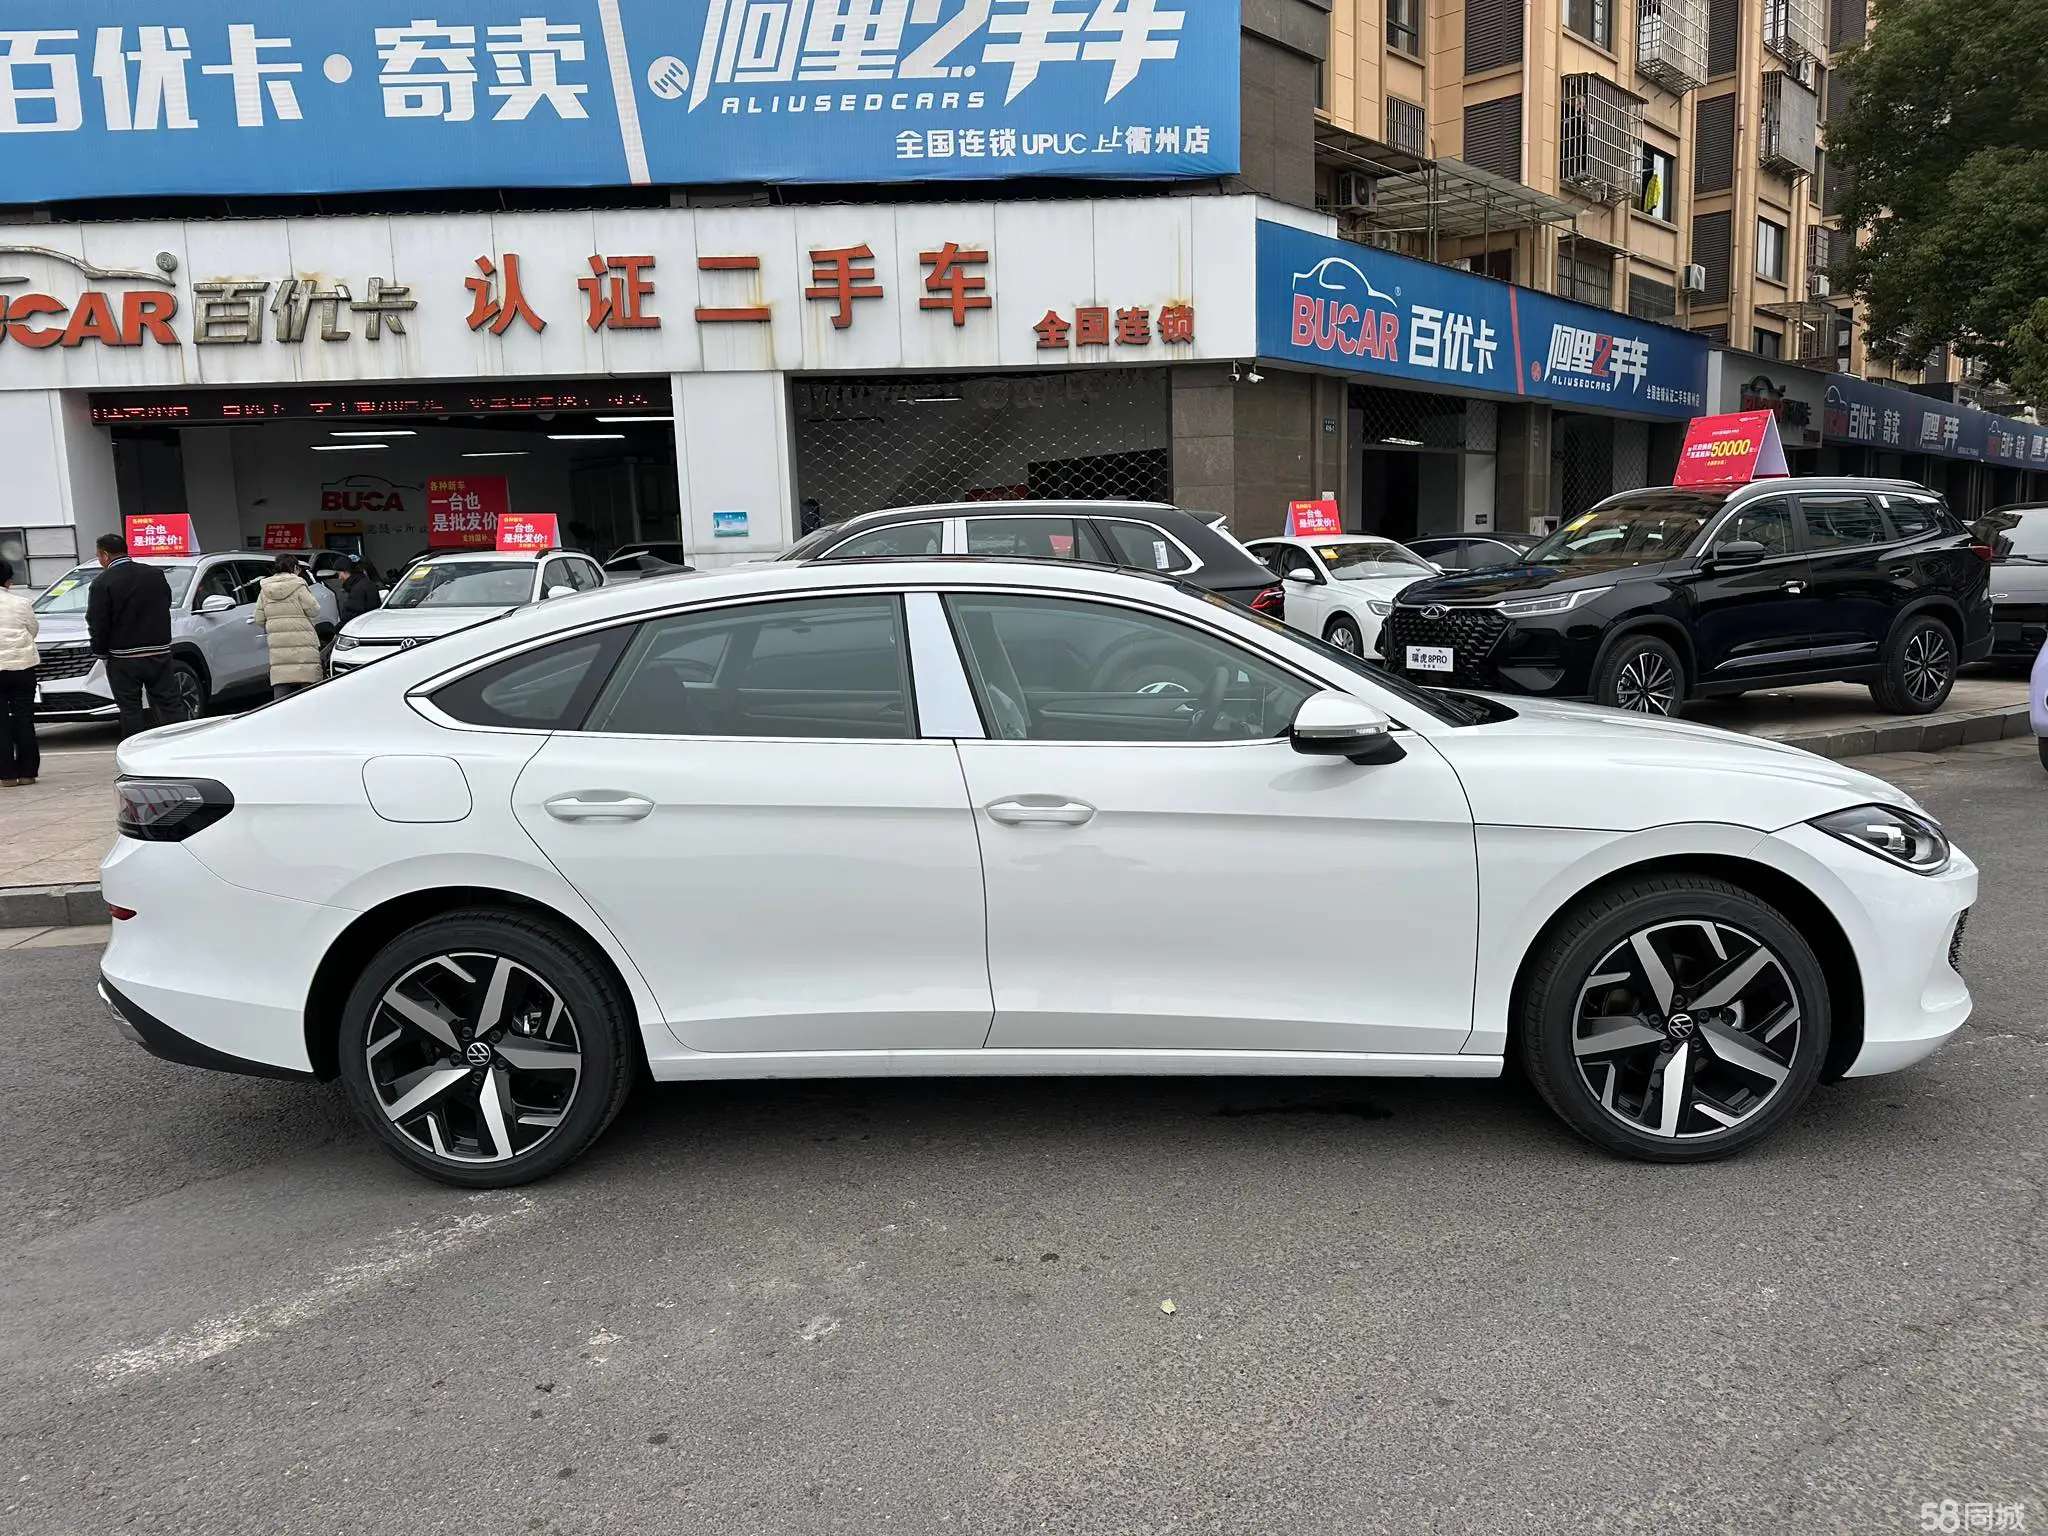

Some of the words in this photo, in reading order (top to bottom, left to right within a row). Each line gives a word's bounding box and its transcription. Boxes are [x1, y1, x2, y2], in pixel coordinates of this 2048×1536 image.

[721, 91, 985, 114] ALIUSEDCARS
[192, 277, 418, 346] 百优卡
[464, 242, 992, 333] 认证二手车
[0, 291, 182, 349] CAR
[1033, 304, 1195, 349] 全国连锁
[1291, 292, 1400, 362] BUCAR
[1409, 304, 1499, 375] 百优卡
[1551, 375, 1612, 393] ALIUSEDCARS
[1710, 438, 1751, 458] 50000
[431, 491, 481, 512] 一台也
